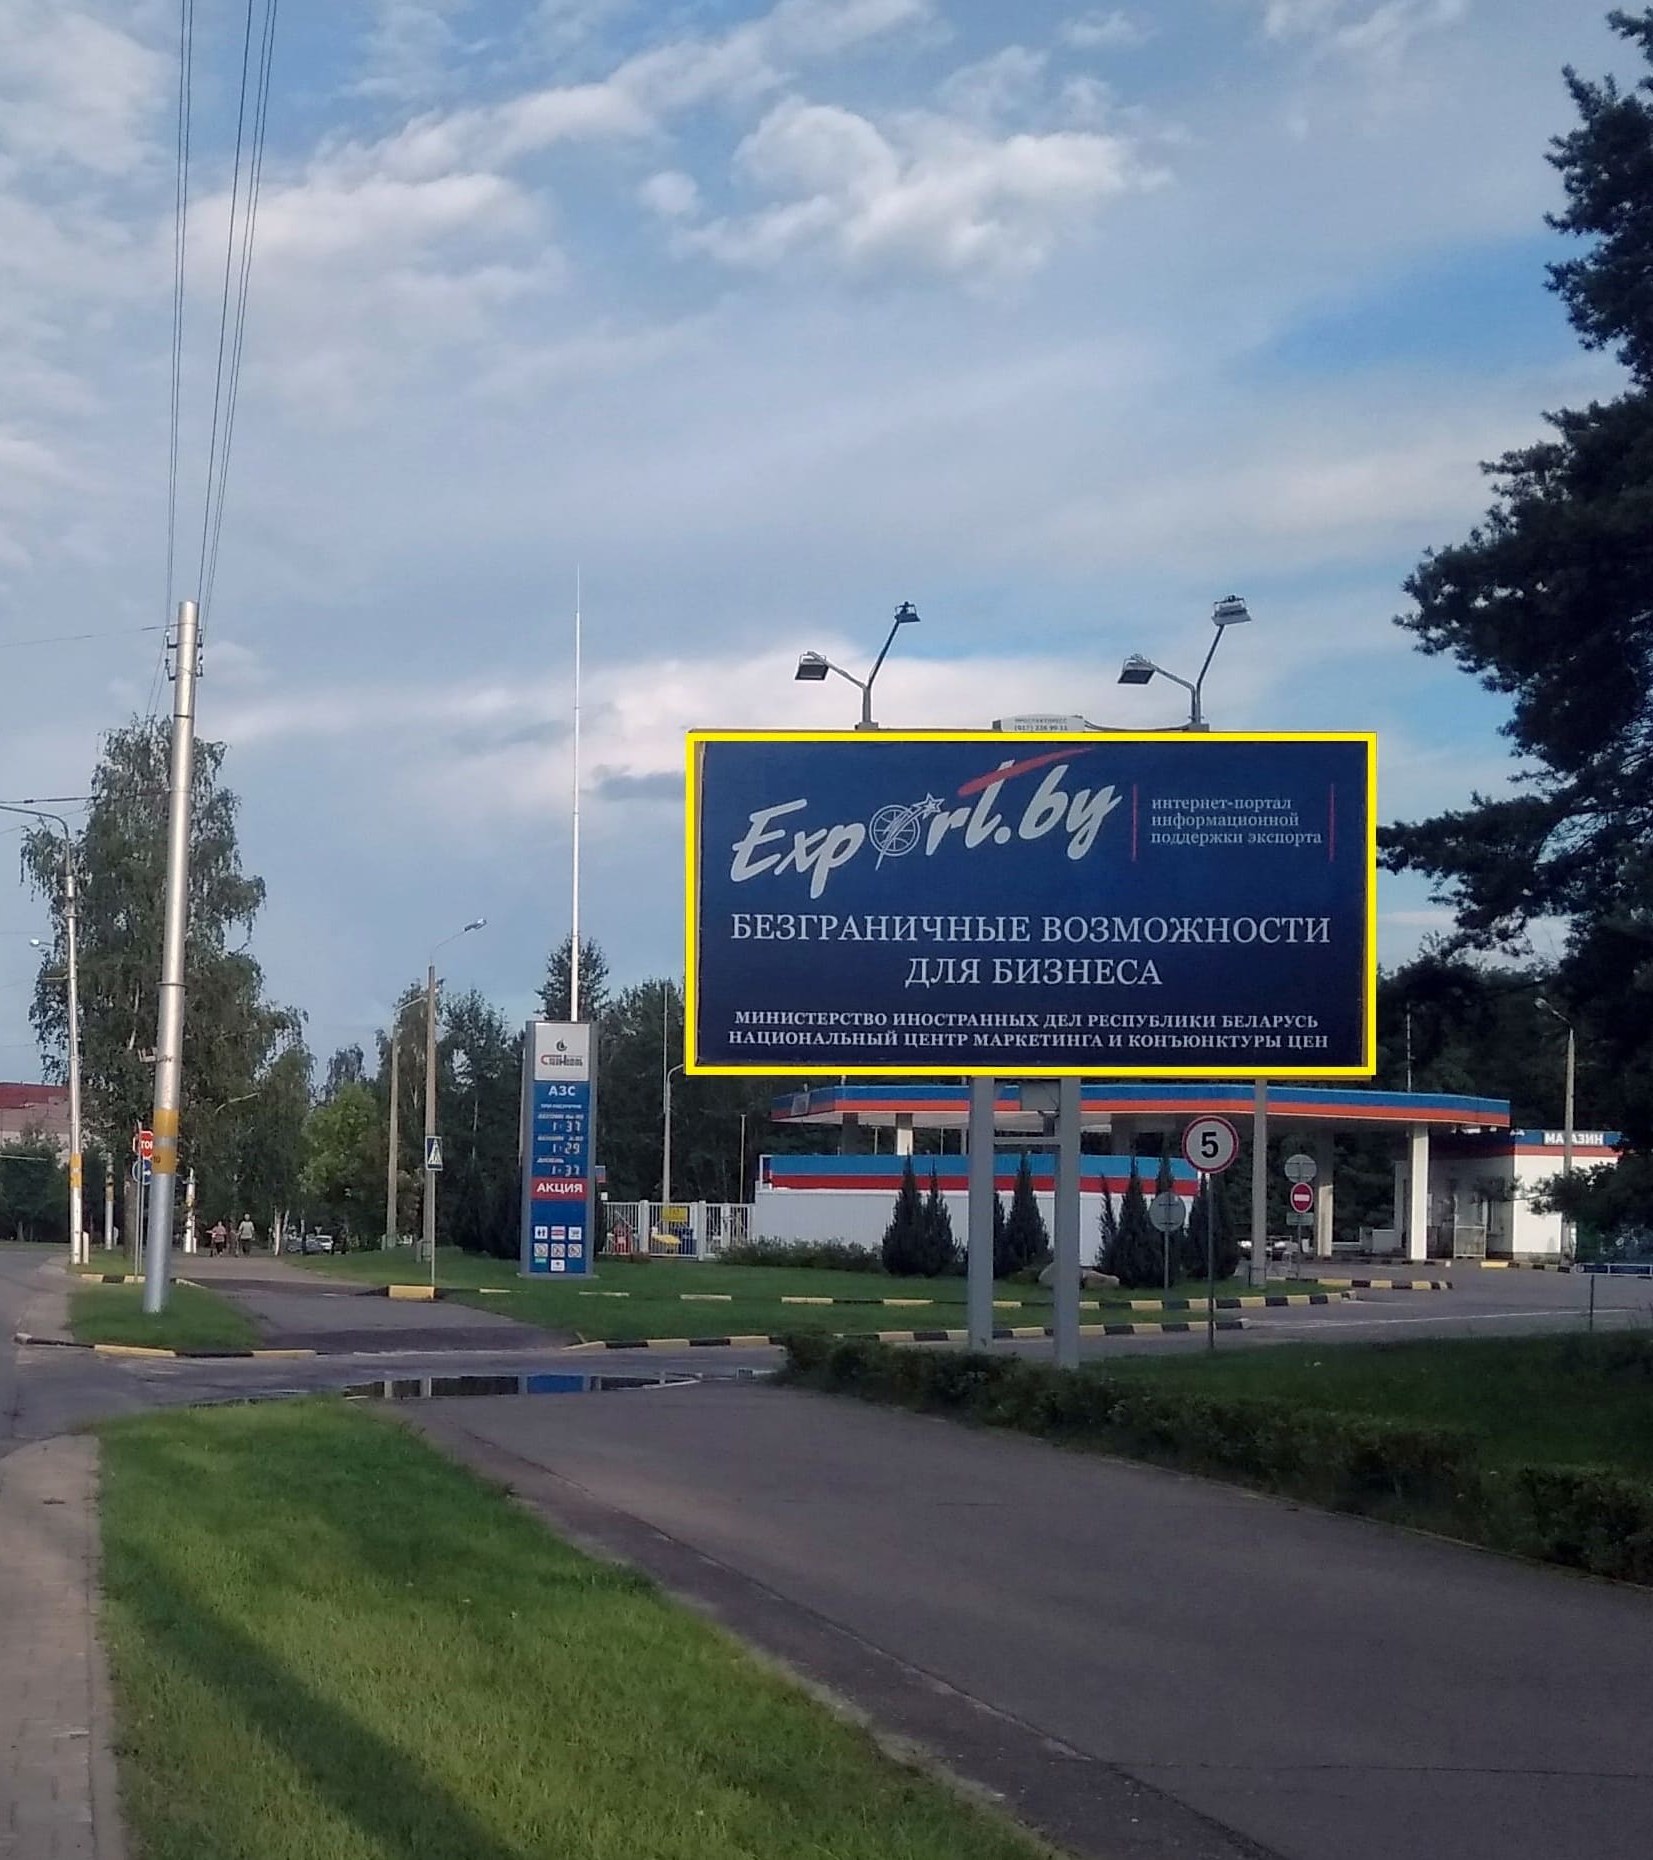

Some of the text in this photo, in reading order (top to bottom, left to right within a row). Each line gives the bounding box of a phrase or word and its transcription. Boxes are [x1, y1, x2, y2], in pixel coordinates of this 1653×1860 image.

[1151, 798, 1292, 813] интернет-портал
[730, 748, 1123, 899] Export.by
[1151, 812, 1299, 830] информационной
[1151, 832, 1322, 847] поддержки экспорта
[731, 913, 1331, 944] БЕЗГРАНИЧНЫЕ ВОЗМОЖНОСТИ
[904, 958, 1163, 988] ДЛЯ БИЗНЕСА
[734, 1010, 1319, 1029] МИНИСТЕРСТВО ИНОСТРАННЫХ ДЕЛ РЕСПУБЛИКИ БЕЛАРУСЬ
[728, 1029, 1328, 1050] НАЦИОНАЛЬНЫЙ ЦЕНТР МАРКЕТИНГА И КОНЪЮНКТУРЫ ЦЕН
[548, 1085, 576, 1096] АЗС
[1200, 1131, 1219, 1158] 5
[1545, 1132, 1604, 1145] МААЗИН
[537, 1183, 583, 1194] АКЦИЯ
